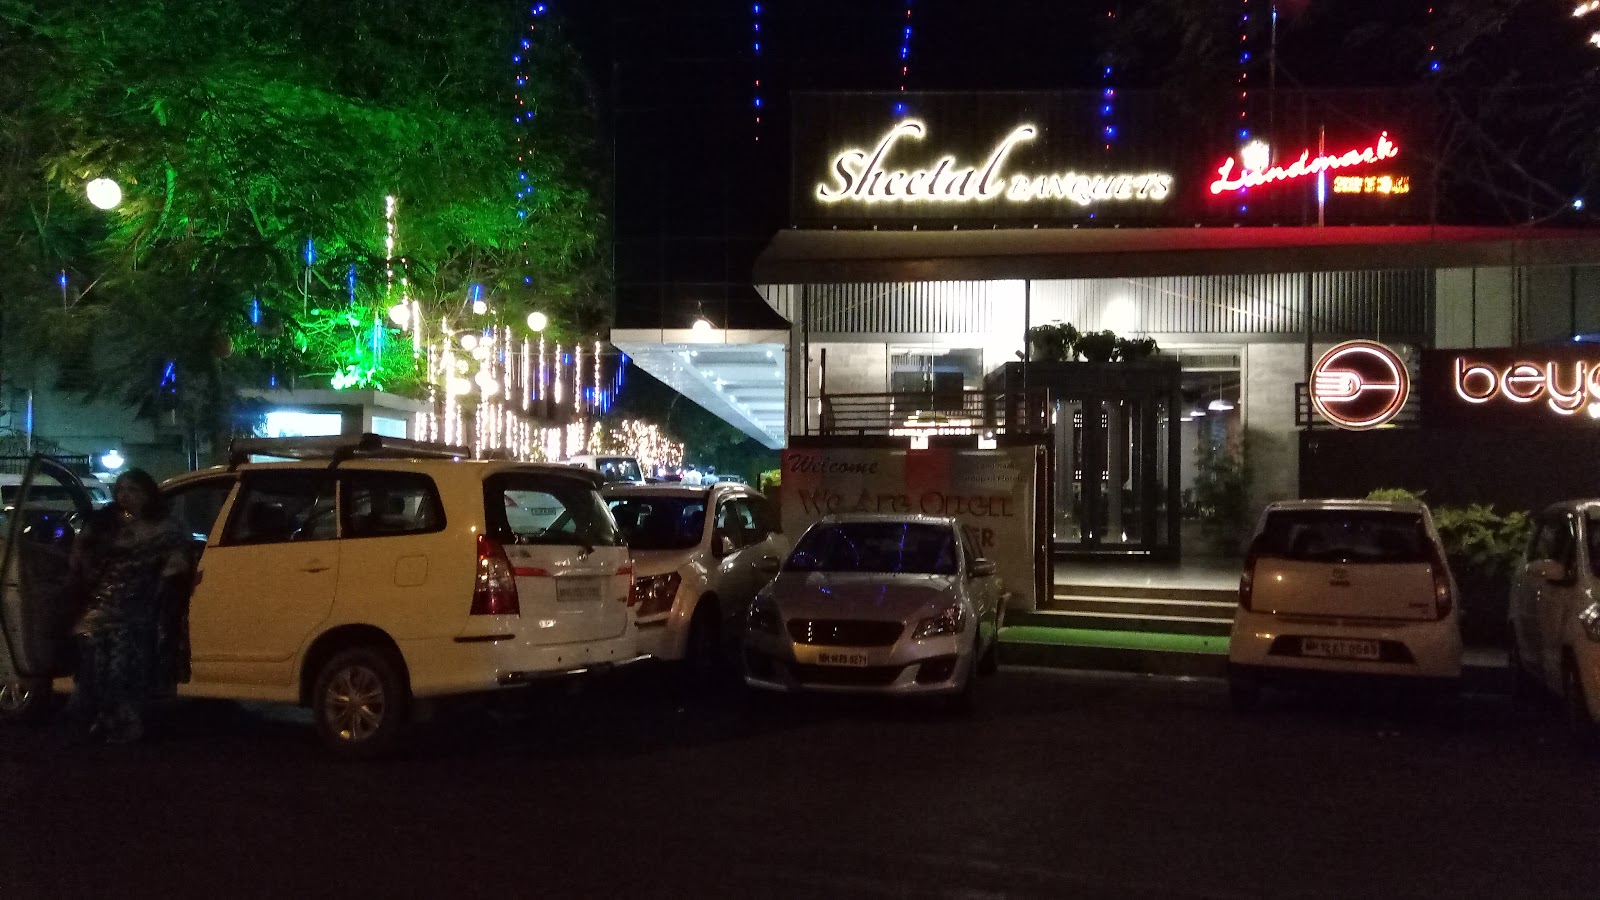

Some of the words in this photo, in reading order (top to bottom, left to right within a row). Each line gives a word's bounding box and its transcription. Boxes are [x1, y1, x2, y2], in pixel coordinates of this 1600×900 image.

[816, 118, 1037, 202] Sheetal
[1008, 172, 1174, 205] BANQUETS
[1455, 357, 1600, 415] bey
[788, 455, 880, 475] Welcome
